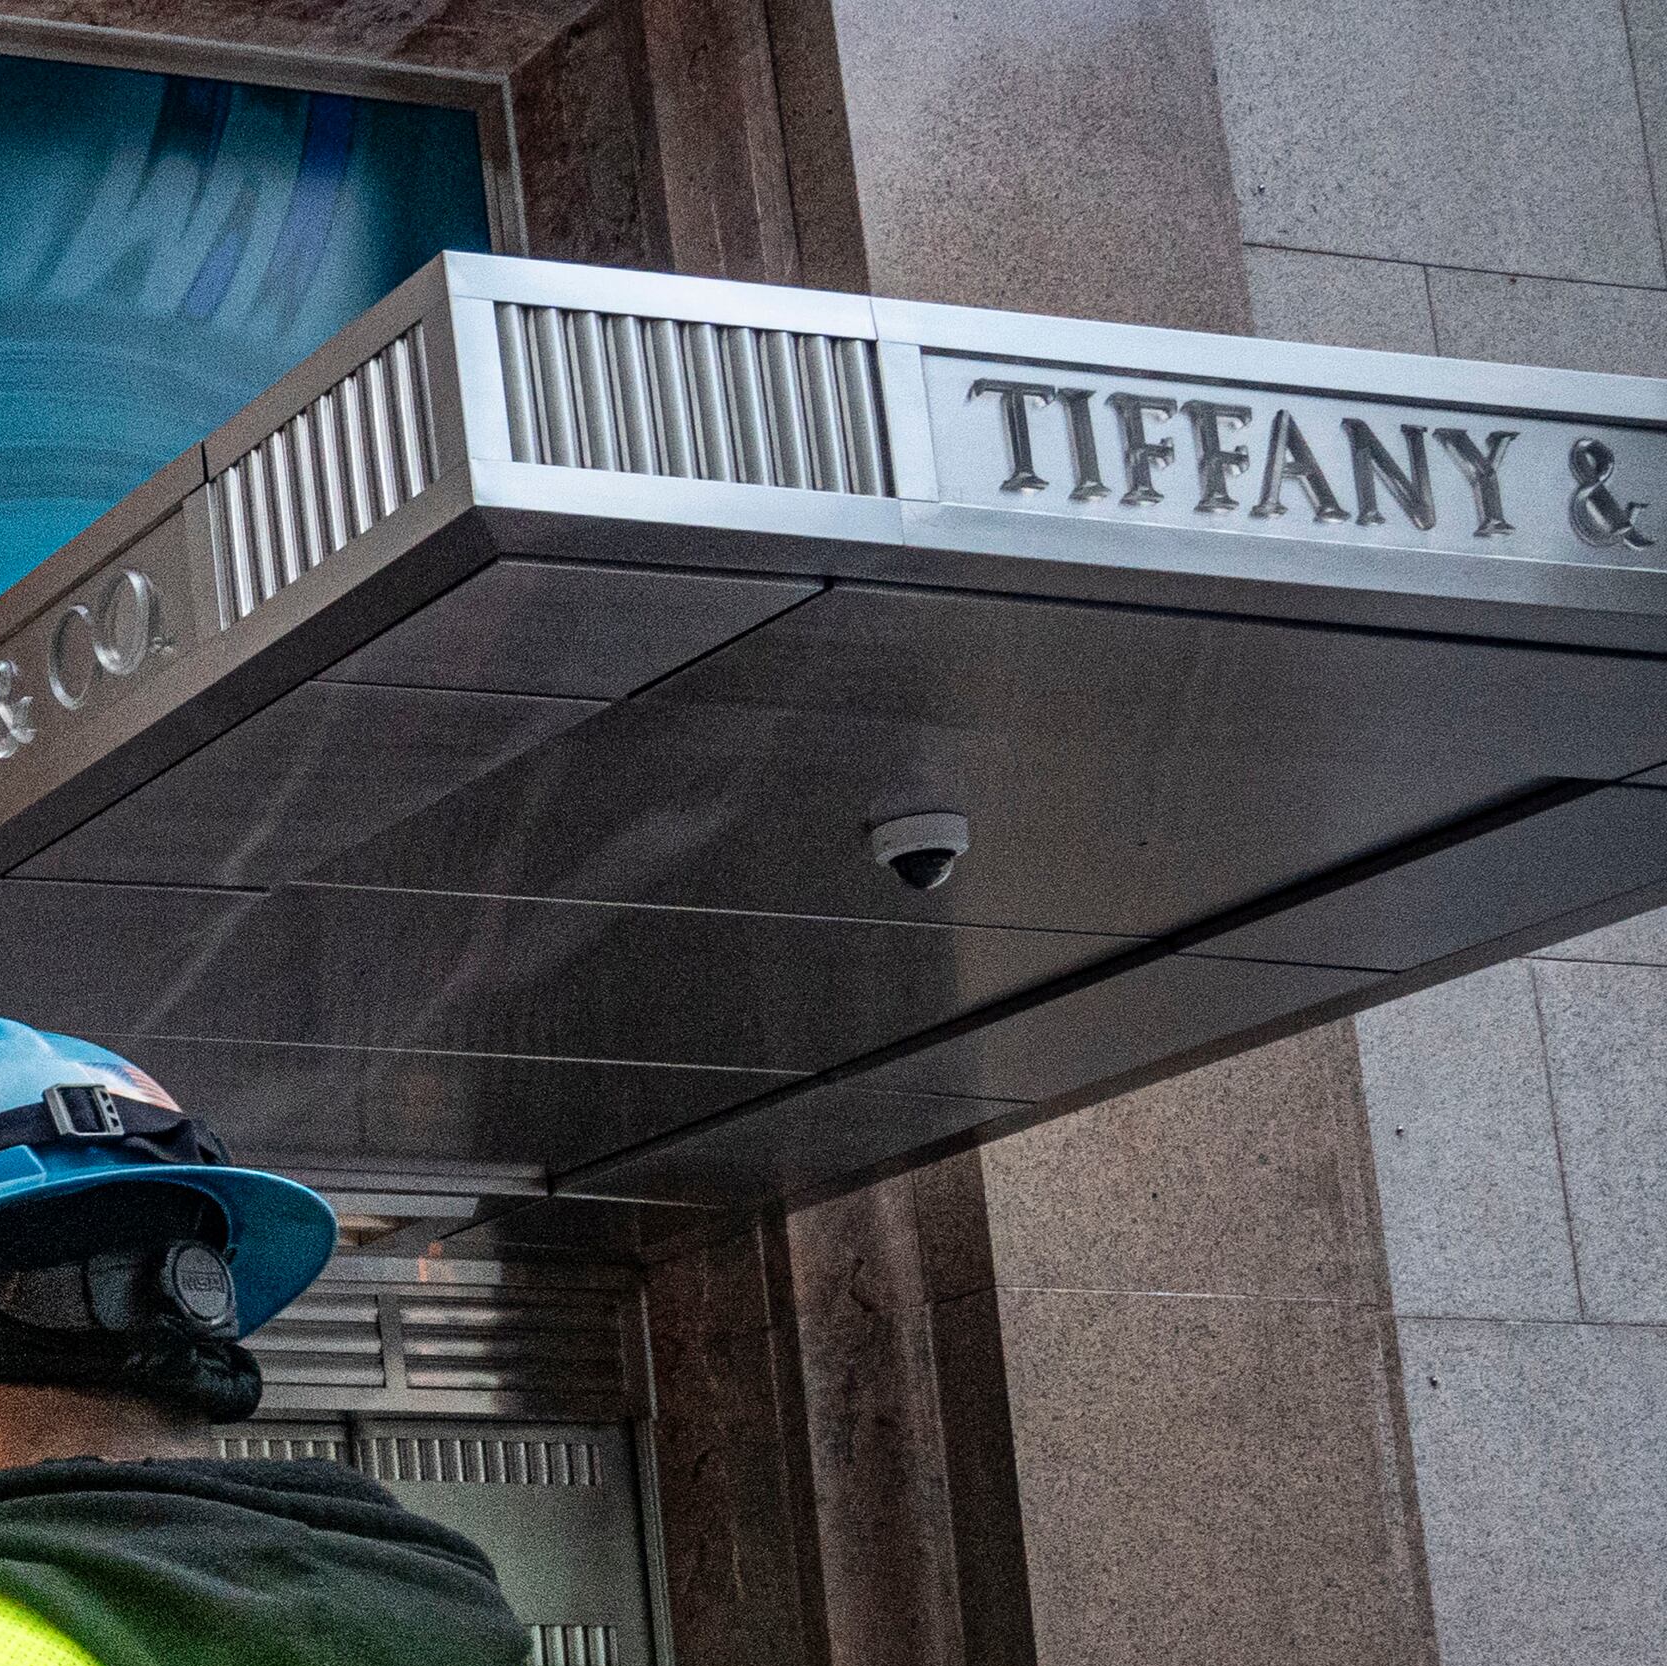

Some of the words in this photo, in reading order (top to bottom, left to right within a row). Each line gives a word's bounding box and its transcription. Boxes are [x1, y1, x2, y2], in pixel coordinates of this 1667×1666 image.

[967, 377, 1520, 538] TIFFANY
[1567, 437, 1657, 551] &
[47, 569, 175, 710] CO.
